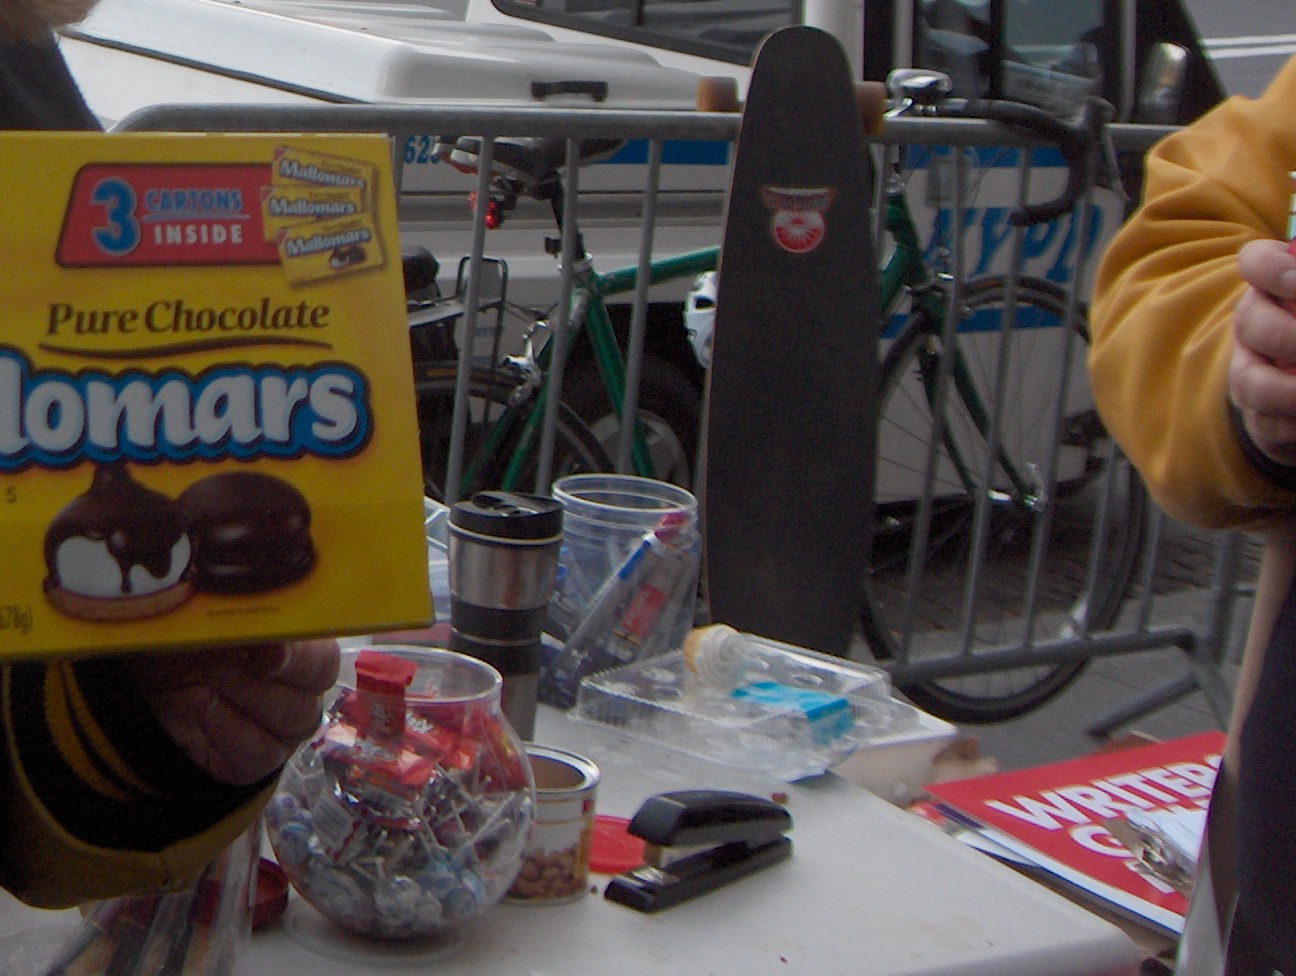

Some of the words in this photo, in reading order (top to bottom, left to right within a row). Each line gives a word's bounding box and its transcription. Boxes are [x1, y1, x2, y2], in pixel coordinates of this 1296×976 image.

[91, 176, 141, 256] 3
[145, 188, 243, 212] CARTONS
[154, 224, 243, 245] INSIDE
[45, 301, 139, 336] Pure
[144, 296, 331, 334] Chocolate
